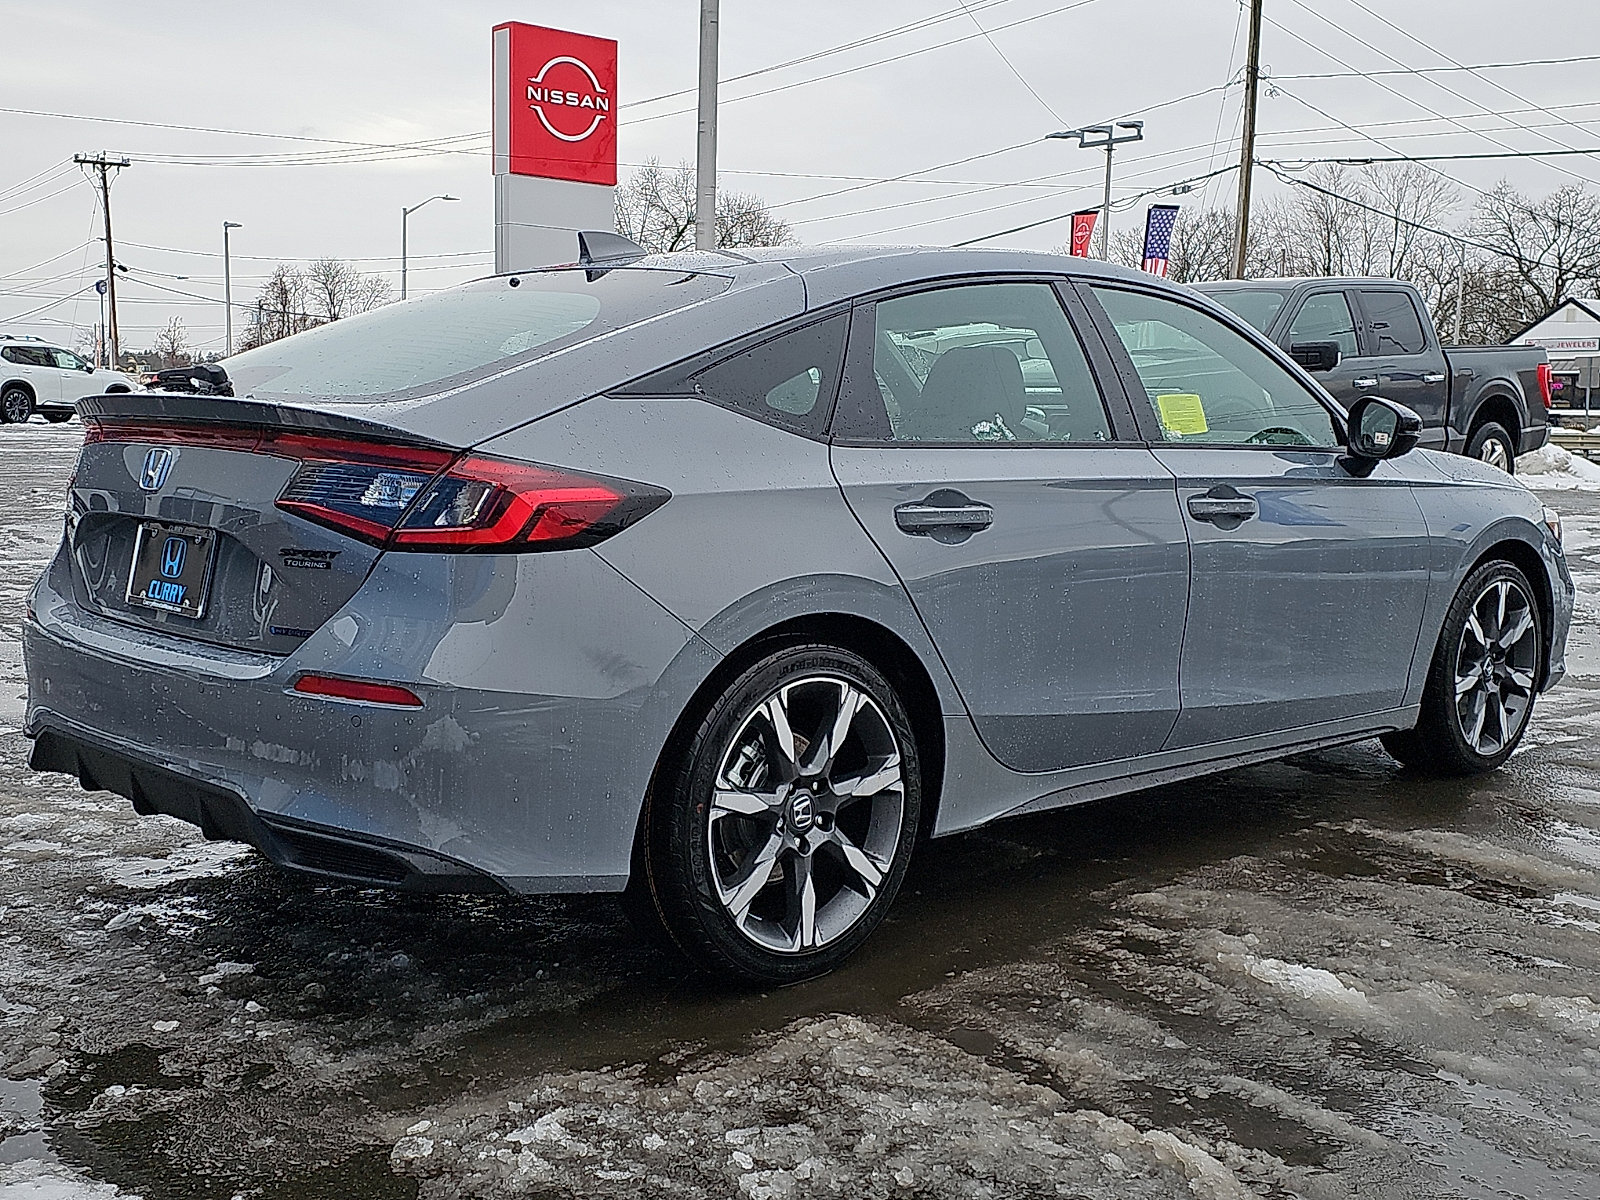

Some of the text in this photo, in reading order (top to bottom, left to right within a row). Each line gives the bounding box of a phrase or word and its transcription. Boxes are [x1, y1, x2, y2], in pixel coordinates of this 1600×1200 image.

[527, 86, 609, 111] NISSAN
[1556, 341, 1597, 349] JEWELERS
[286, 559, 327, 568] TOURING
[148, 579, 187, 604] CURRY
